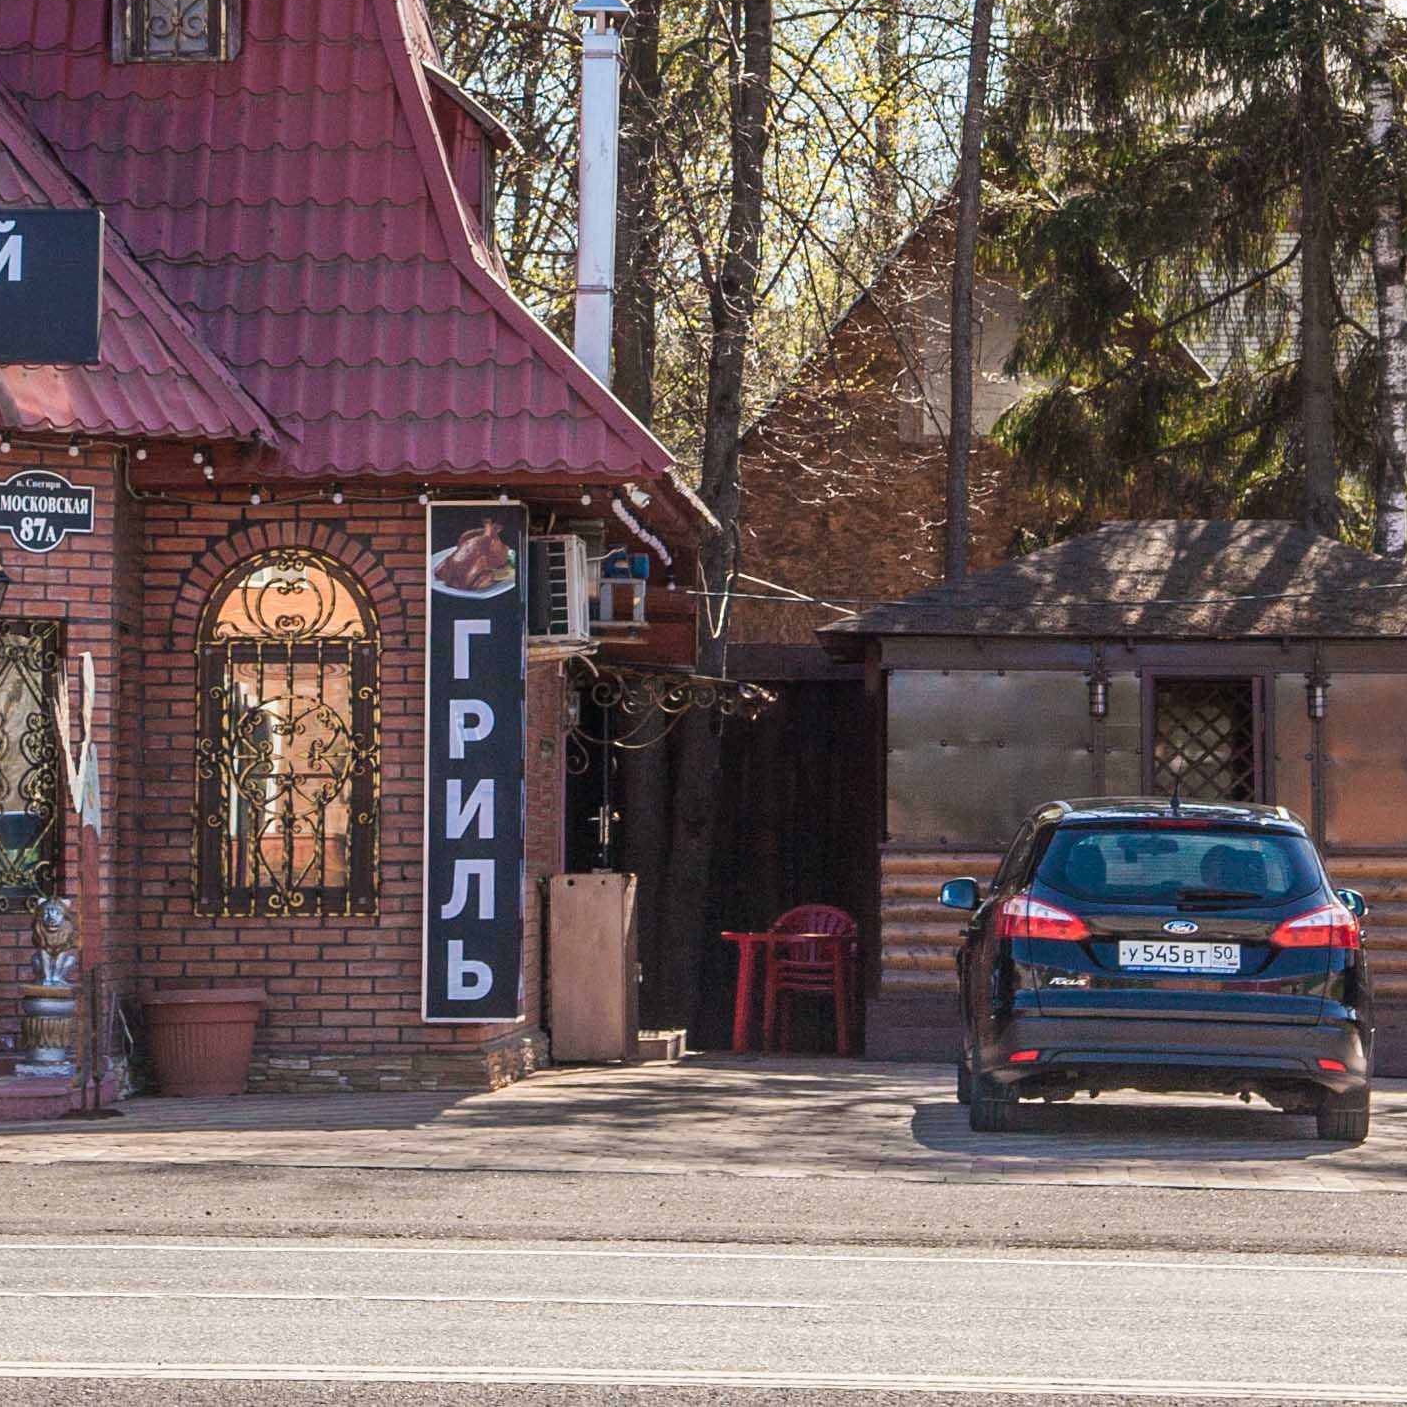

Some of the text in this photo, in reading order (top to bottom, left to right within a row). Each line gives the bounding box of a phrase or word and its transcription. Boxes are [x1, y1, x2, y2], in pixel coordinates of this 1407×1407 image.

[0, 495, 89, 514] МОСКОВСКАЯ
[20, 517, 57, 542] 87А
[441, 619, 495, 1001] ГРИЛЬ
[1213, 946, 1233, 960] 50
